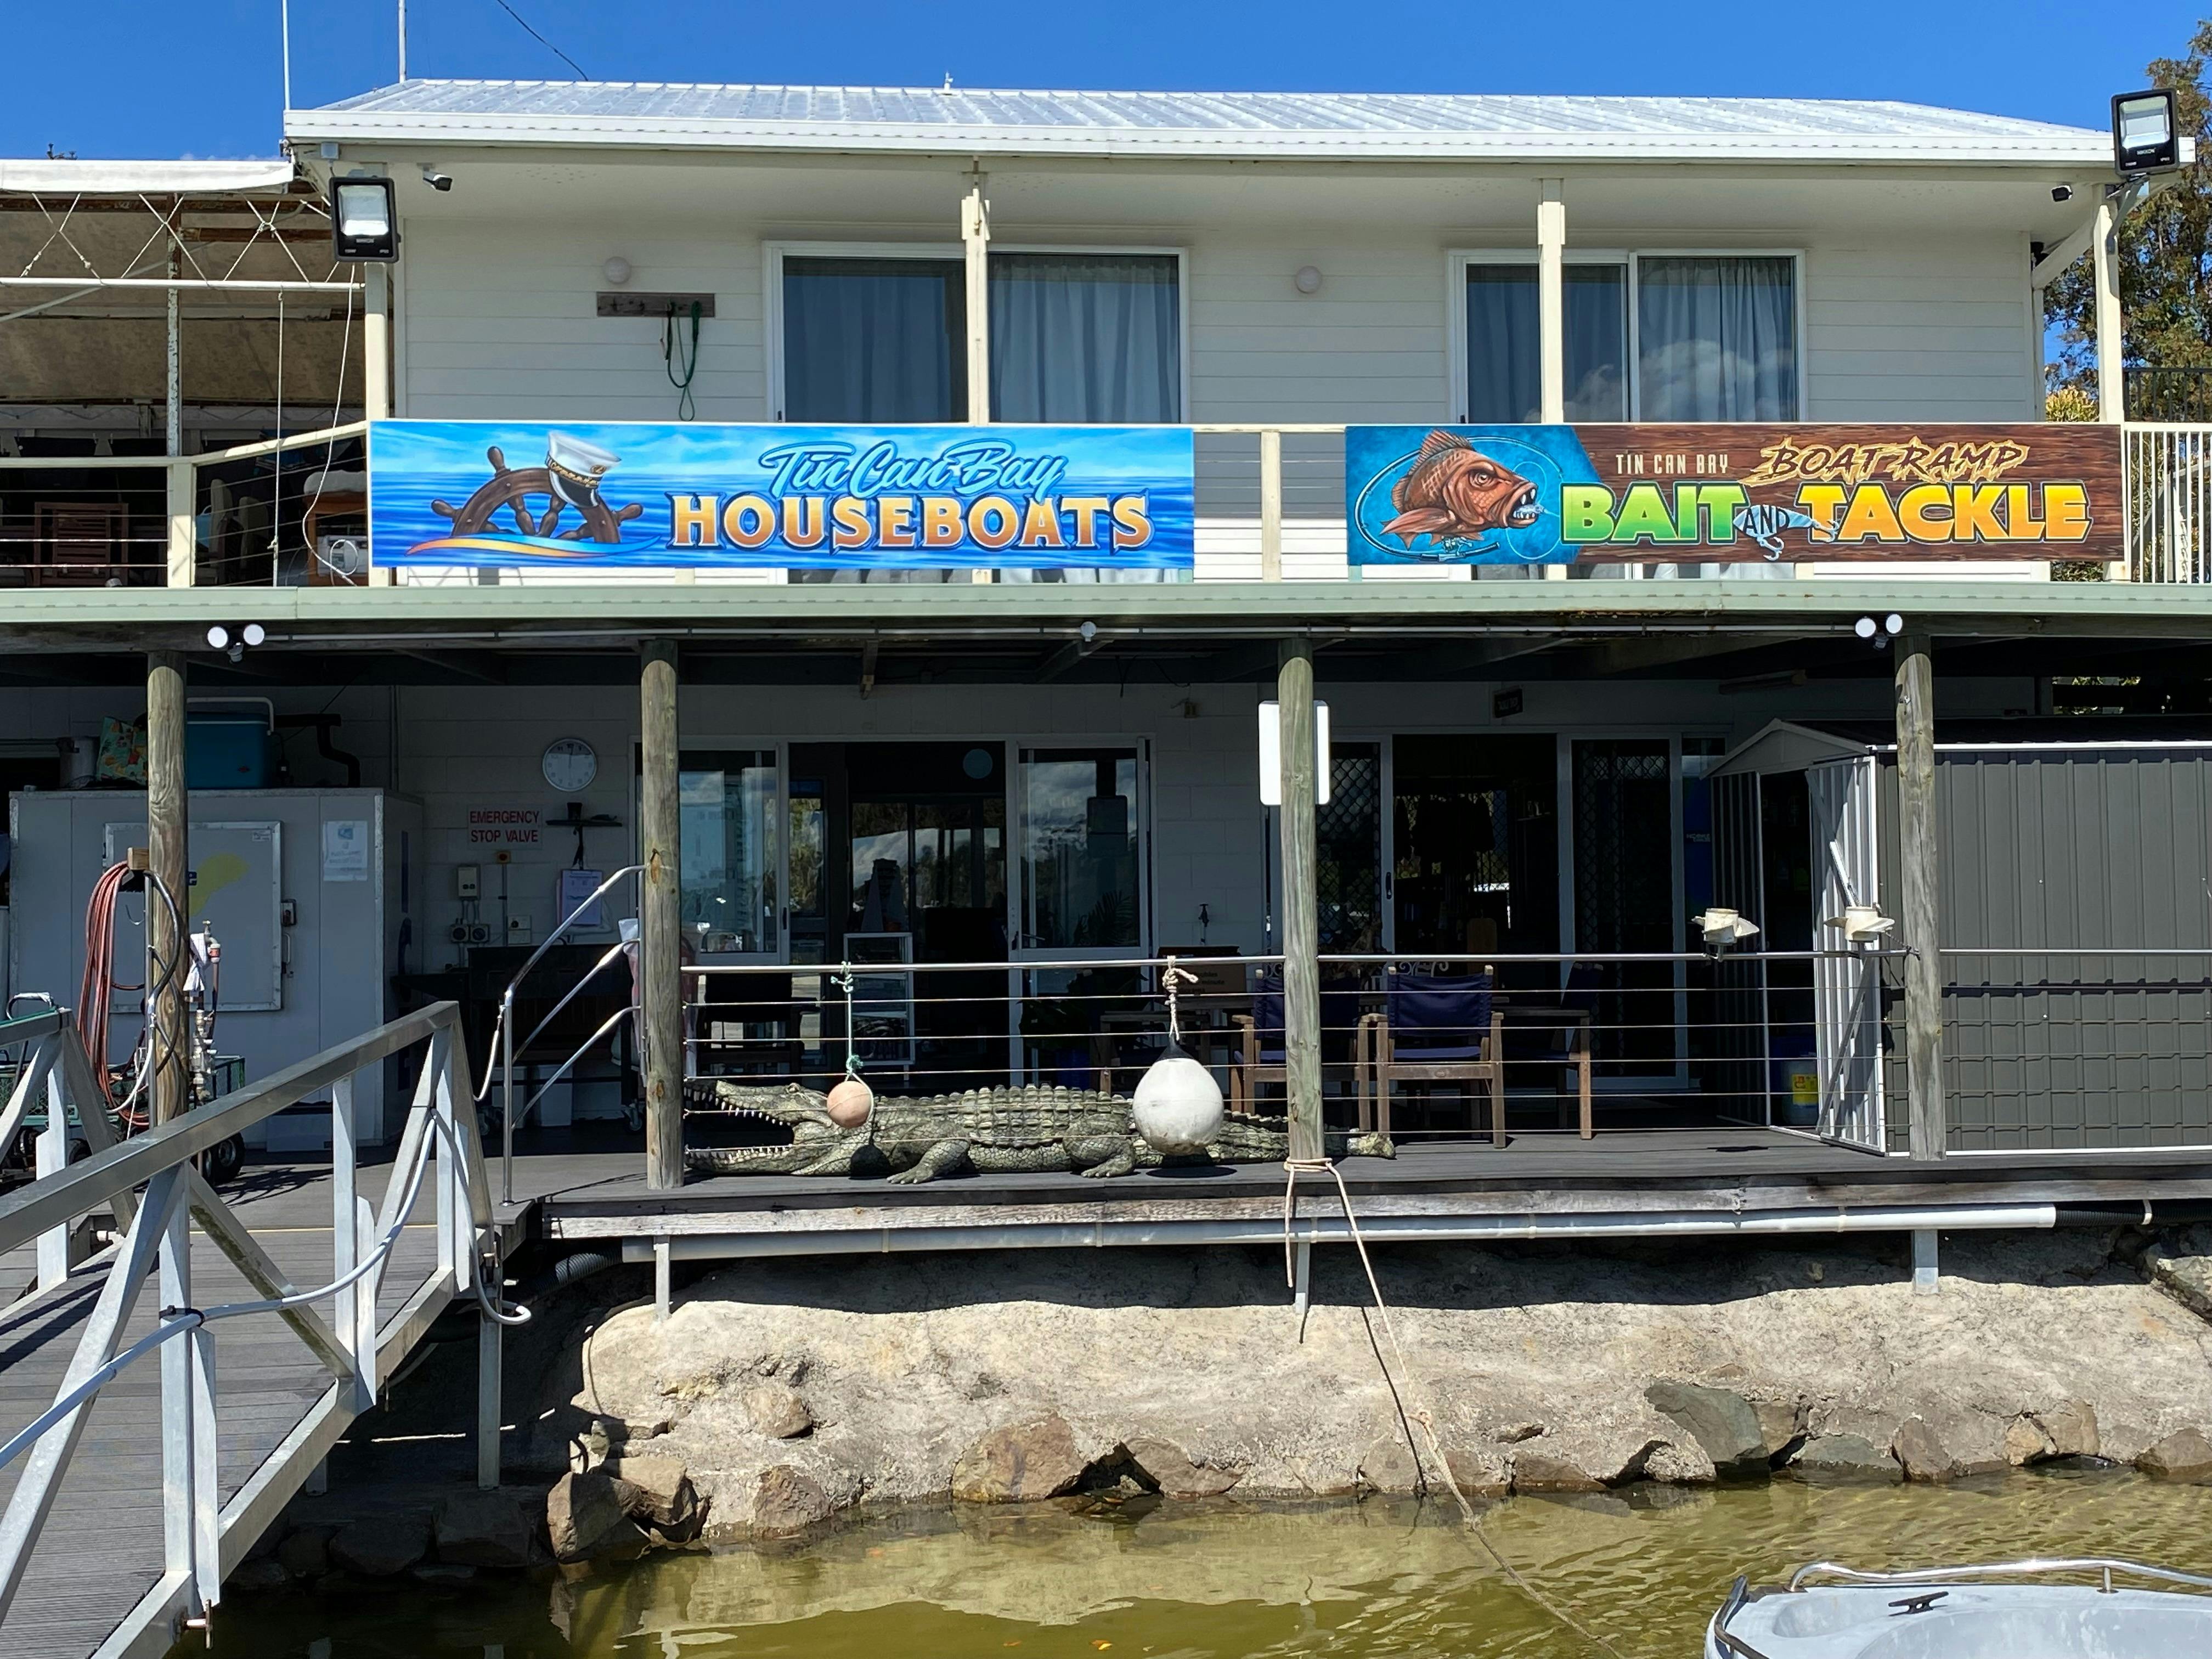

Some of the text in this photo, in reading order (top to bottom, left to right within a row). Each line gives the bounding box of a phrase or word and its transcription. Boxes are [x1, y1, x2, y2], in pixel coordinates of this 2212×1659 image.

[760, 437, 1069, 504] Tin Can Bay
[1615, 454, 1728, 475] TIN CAN BAY
[1753, 439, 2027, 483] BOAT RAMP
[668, 492, 1153, 552] HOUSEBOATS
[1562, 483, 2091, 543] BAIT AND TACKLE
[470, 810, 540, 823] EMERGENCY
[471, 830, 538, 843] STOP VALVE
